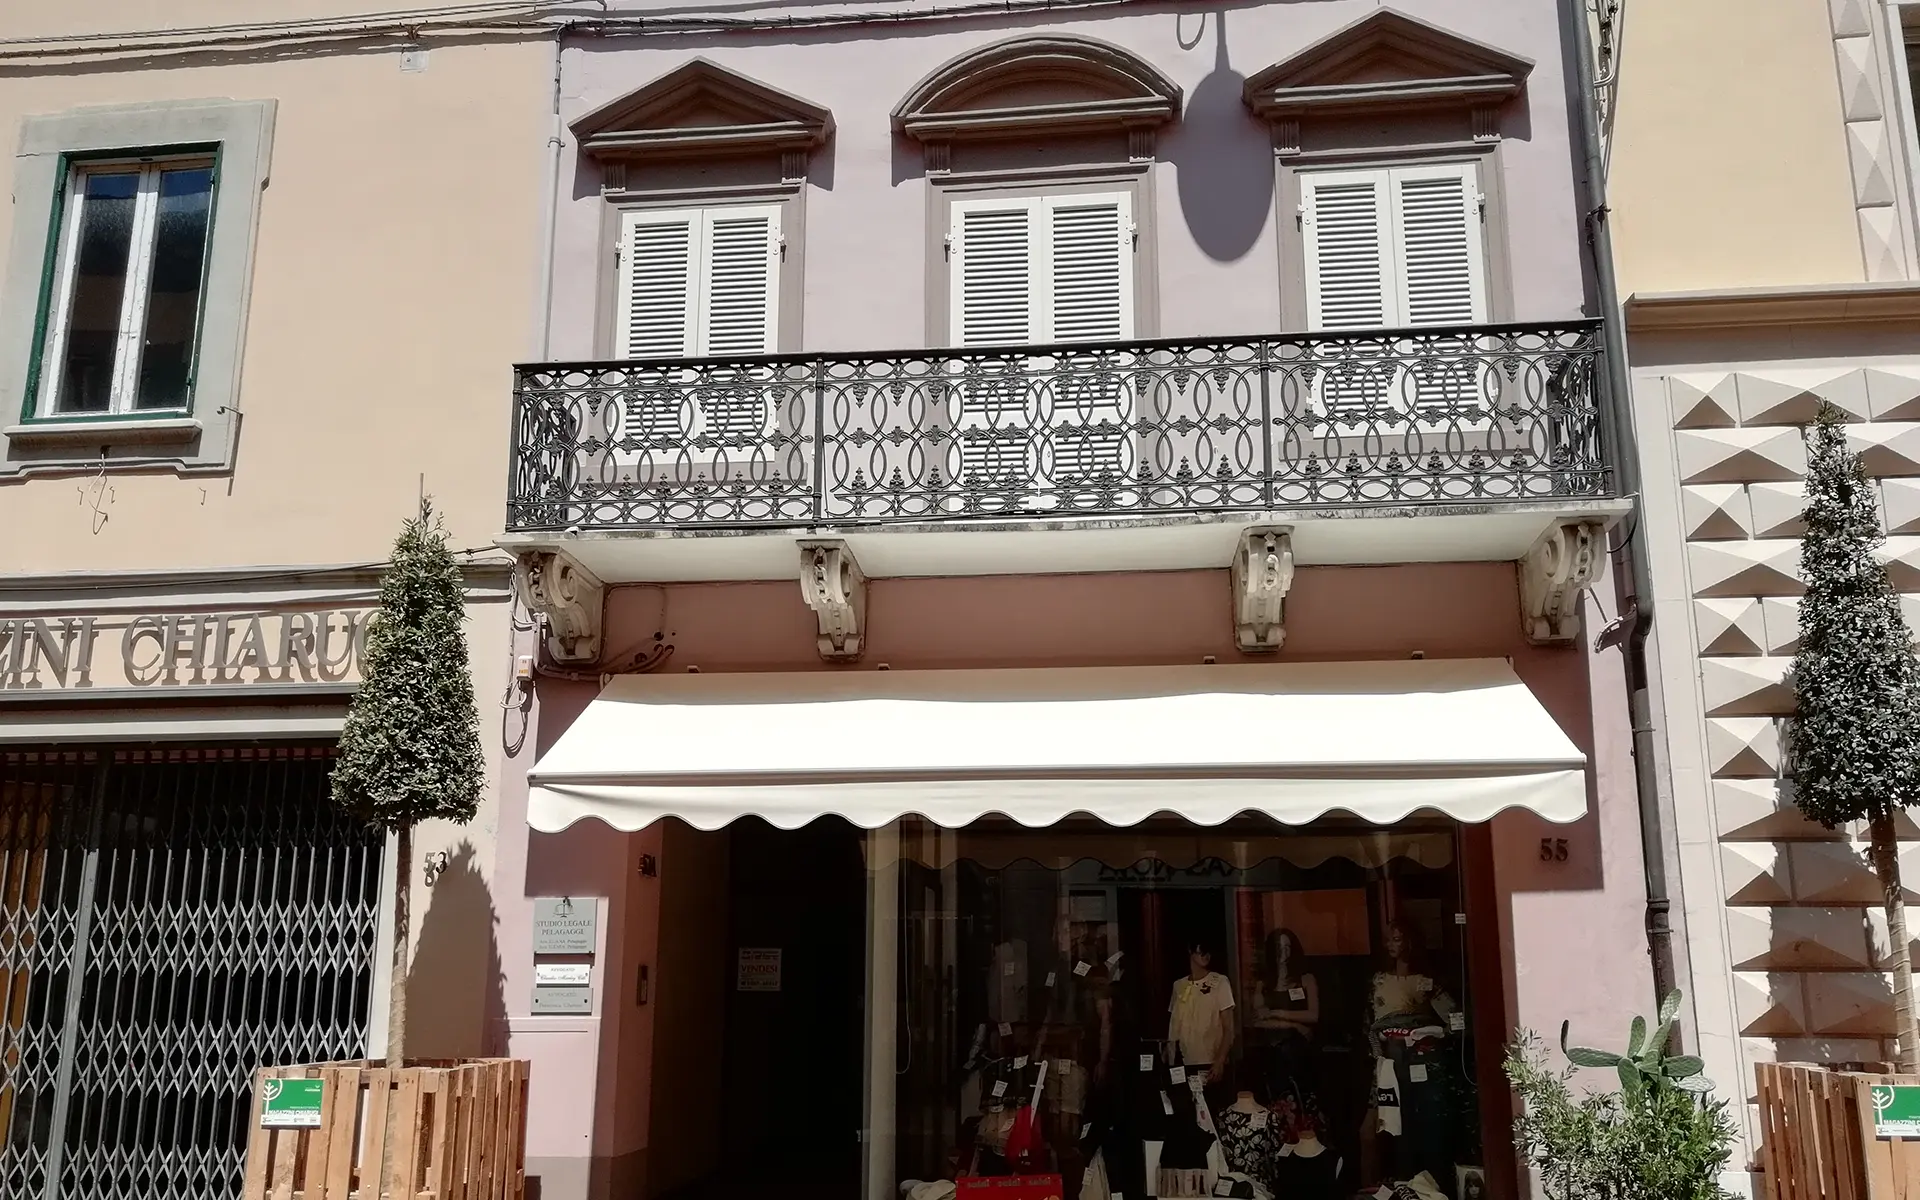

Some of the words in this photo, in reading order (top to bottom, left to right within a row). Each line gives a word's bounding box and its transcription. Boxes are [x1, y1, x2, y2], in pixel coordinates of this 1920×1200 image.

[1540, 837, 1568, 862] 55
[423, 850, 447, 874] 53
[741, 964, 778, 973] VENDESI
